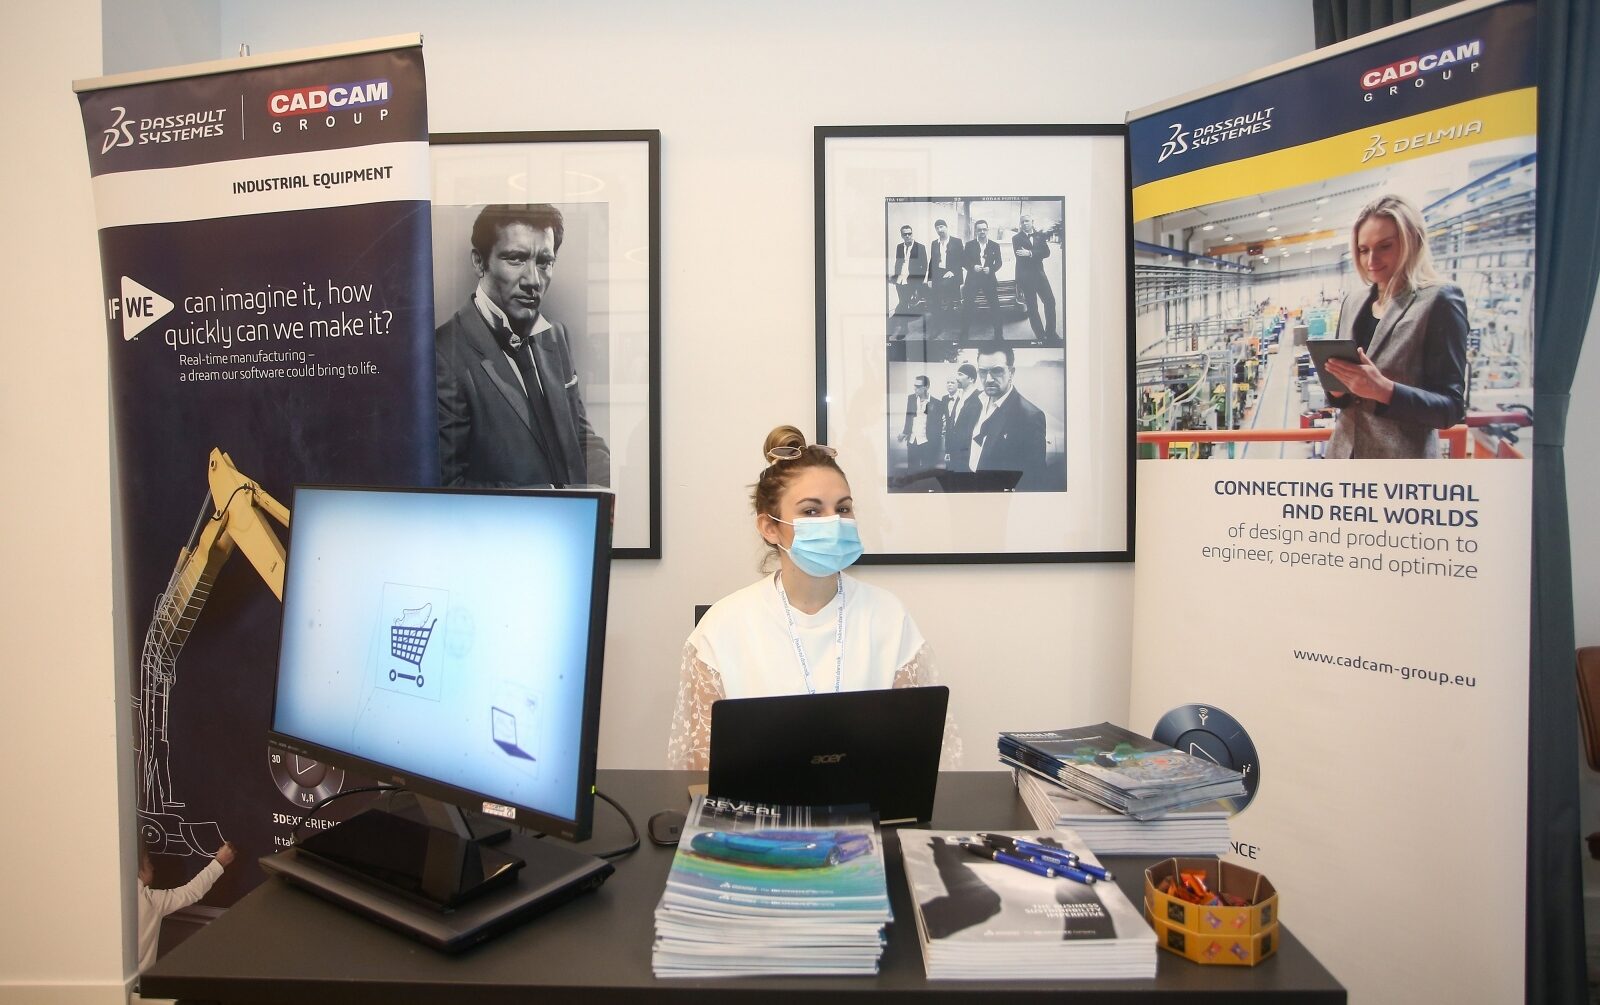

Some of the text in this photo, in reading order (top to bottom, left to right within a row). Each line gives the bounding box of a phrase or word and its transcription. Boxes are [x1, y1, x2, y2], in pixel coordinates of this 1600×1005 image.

[1363, 40, 1480, 87] CADCAM
[1363, 62, 1480, 102] GROUP
[270, 82, 388, 114] CADCAM
[140, 108, 227, 131] DASSAULT
[272, 109, 389, 134] GROUP
[1193, 107, 1275, 139] DASSAULT
[138, 124, 224, 145] SYSTEMES
[1191, 120, 1272, 150] SYSTEMES
[1393, 120, 1482, 153] DELMIA
[233, 166, 393, 194] INDUSTRIAL EQUIPMENT
[108, 296, 154, 320] IF WE
[184, 279, 373, 315] can imagine it, how
[165, 310, 393, 351] quickly can we make it?
[179, 350, 229, 367] Real-time
[229, 349, 307, 366] manufacturing
[180, 361, 380, 382] a dream our software could bring to life.
[1214, 480, 1479, 502] CONNECTING THE VIRTUAL
[1282, 503, 1479, 527] AND REAL WORLDS
[1228, 523, 1478, 553] of design and production to
[1202, 544, 1478, 579] engineer, operate and optimize
[1293, 650, 1477, 688] www.cadcam-group.eu
[271, 754, 281, 764] 3D
[703, 798, 781, 816] REVEAL
[272, 812, 341, 830] 3DEXERIEN
[274, 835, 281, 846] It
